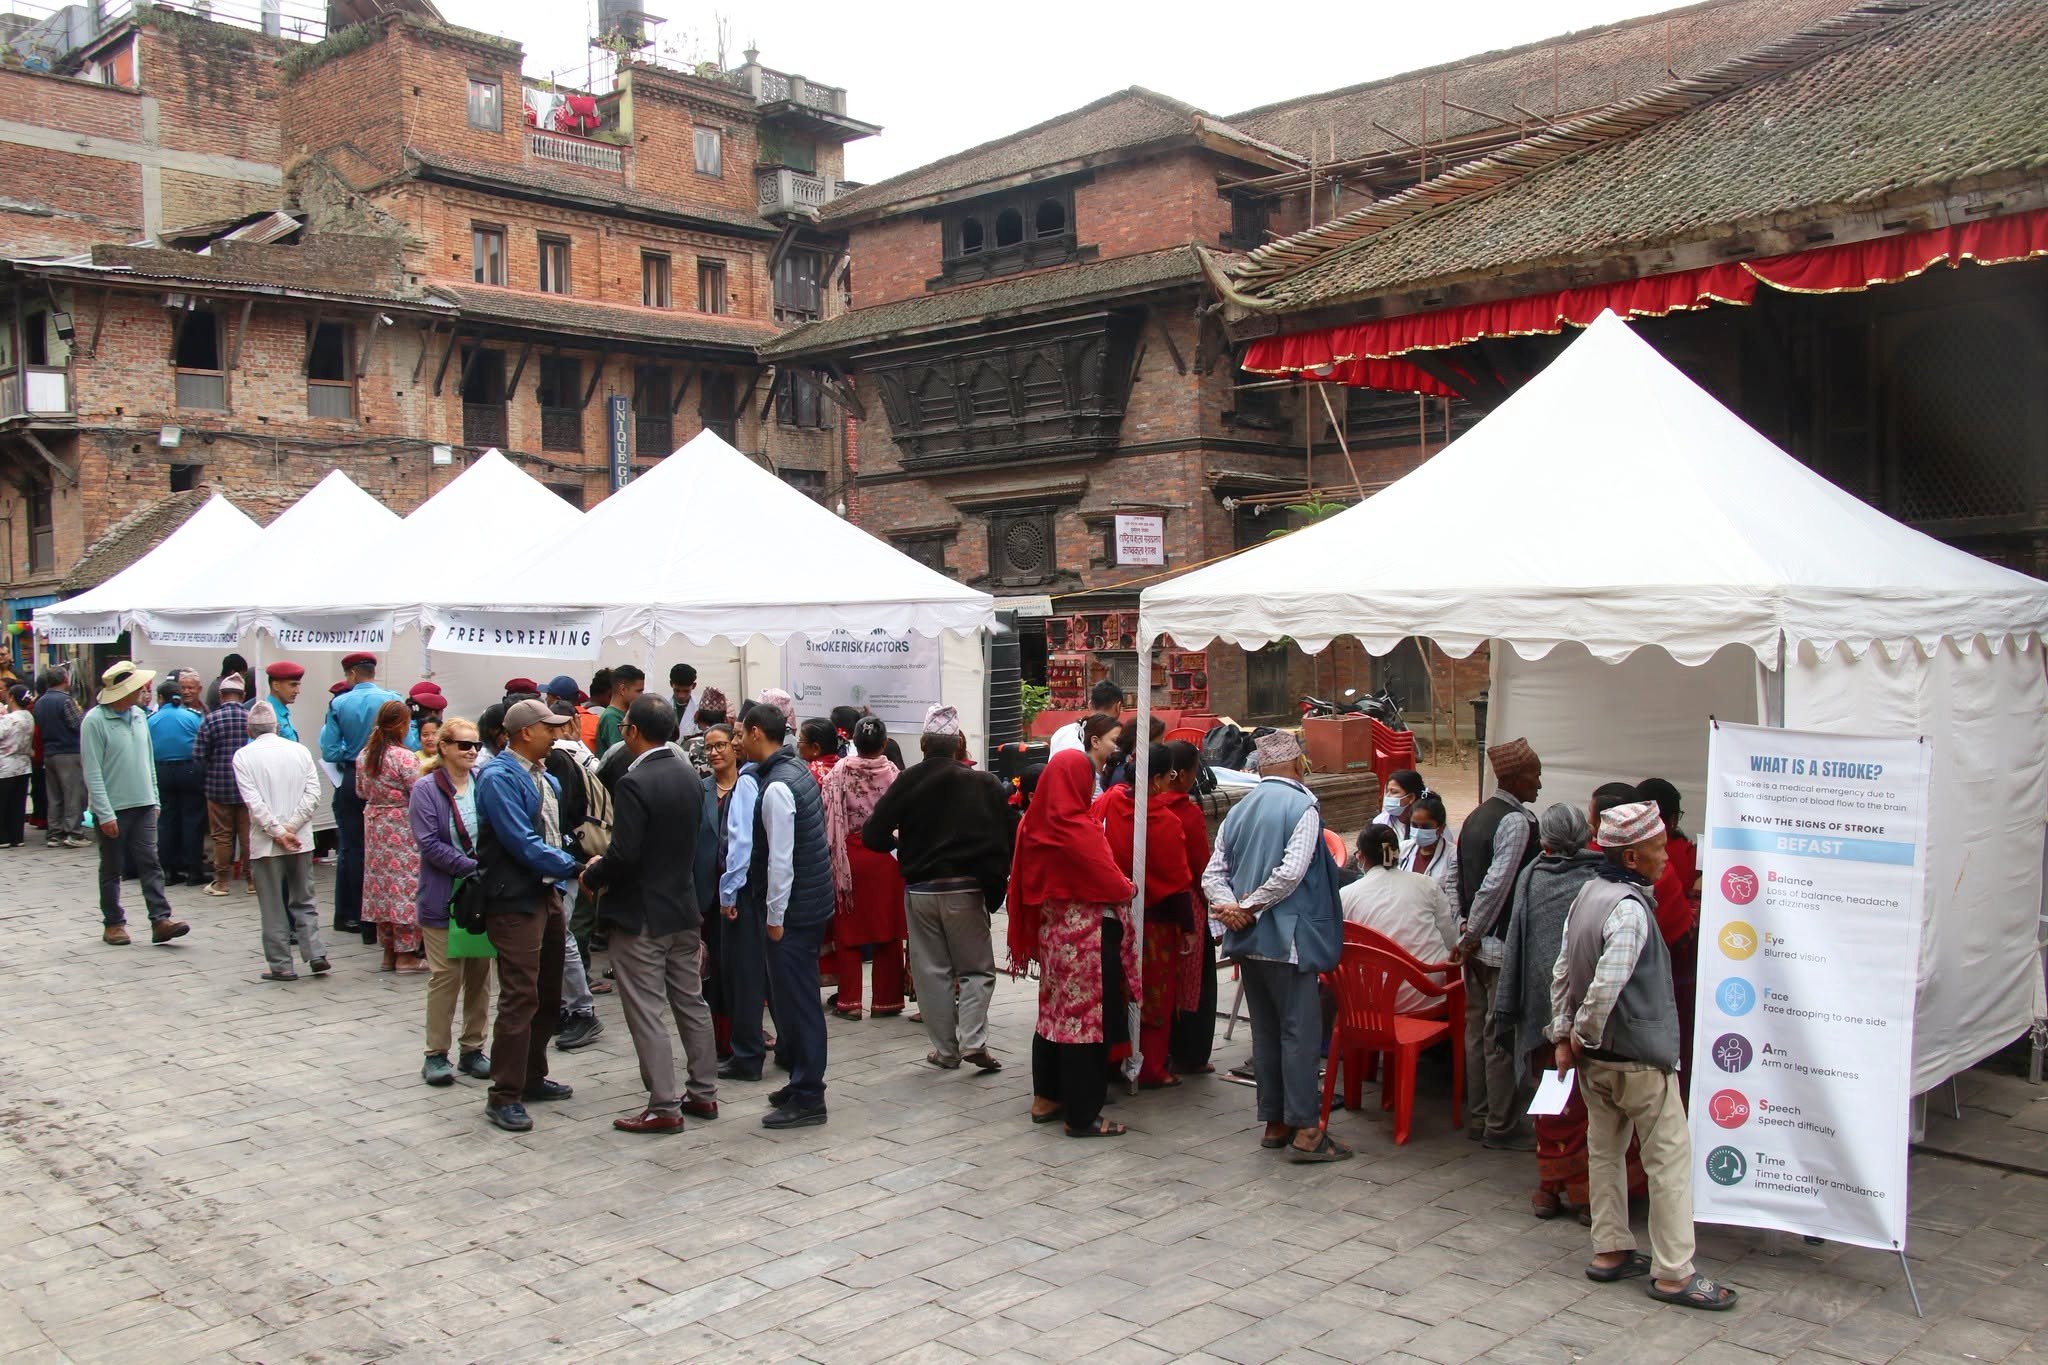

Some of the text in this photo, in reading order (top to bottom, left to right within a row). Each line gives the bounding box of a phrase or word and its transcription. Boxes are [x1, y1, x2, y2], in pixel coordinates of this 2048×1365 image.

[616, 400, 628, 488] UNIQUE GU
[51, 626, 116, 637] FREE CONSULTATION
[279, 629, 384, 643] FREE CONSULTATION
[446, 627, 590, 646] FREE SCREENING
[807, 640, 909, 652] STROKE RISK FACTORS
[1750, 756, 1883, 780] WHAT IS A STROKE?
[1736, 780, 1761, 789] Stroke
[1763, 782, 1770, 790] is
[1780, 783, 1814, 792] medical
[1816, 786, 1864, 798] emergency
[1867, 789, 1885, 798] due
[1724, 790, 1906, 812] sudden disruption of blood flow to the brain
[1741, 815, 1885, 834] KNOW THE SIGNS OF STROKE
[1777, 837, 1843, 855] BEFAST
[1768, 872, 1813, 886] Balance
[1767, 887, 1898, 907] Loss of balance, headache
[1779, 899, 1820, 910] dizziness
[1764, 932, 1784, 946] Eye
[1764, 949, 1826, 963] Blurred vision
[1764, 988, 1788, 1002] Face
[1764, 1004, 1886, 1027] Face drooping to one side
[1762, 1043, 1787, 1057] Arm
[1762, 1058, 1782, 1068] Arm
[1795, 1063, 1808, 1075] leg
[1811, 1066, 1859, 1080] weakness
[1759, 1099, 1801, 1115] Speech
[1758, 1116, 1835, 1137] Speech difficulty
[1756, 1152, 1785, 1166] Time
[1755, 1179, 1819, 1196] immediately
[1756, 1169, 1885, 1199] Time to call for ambulance
